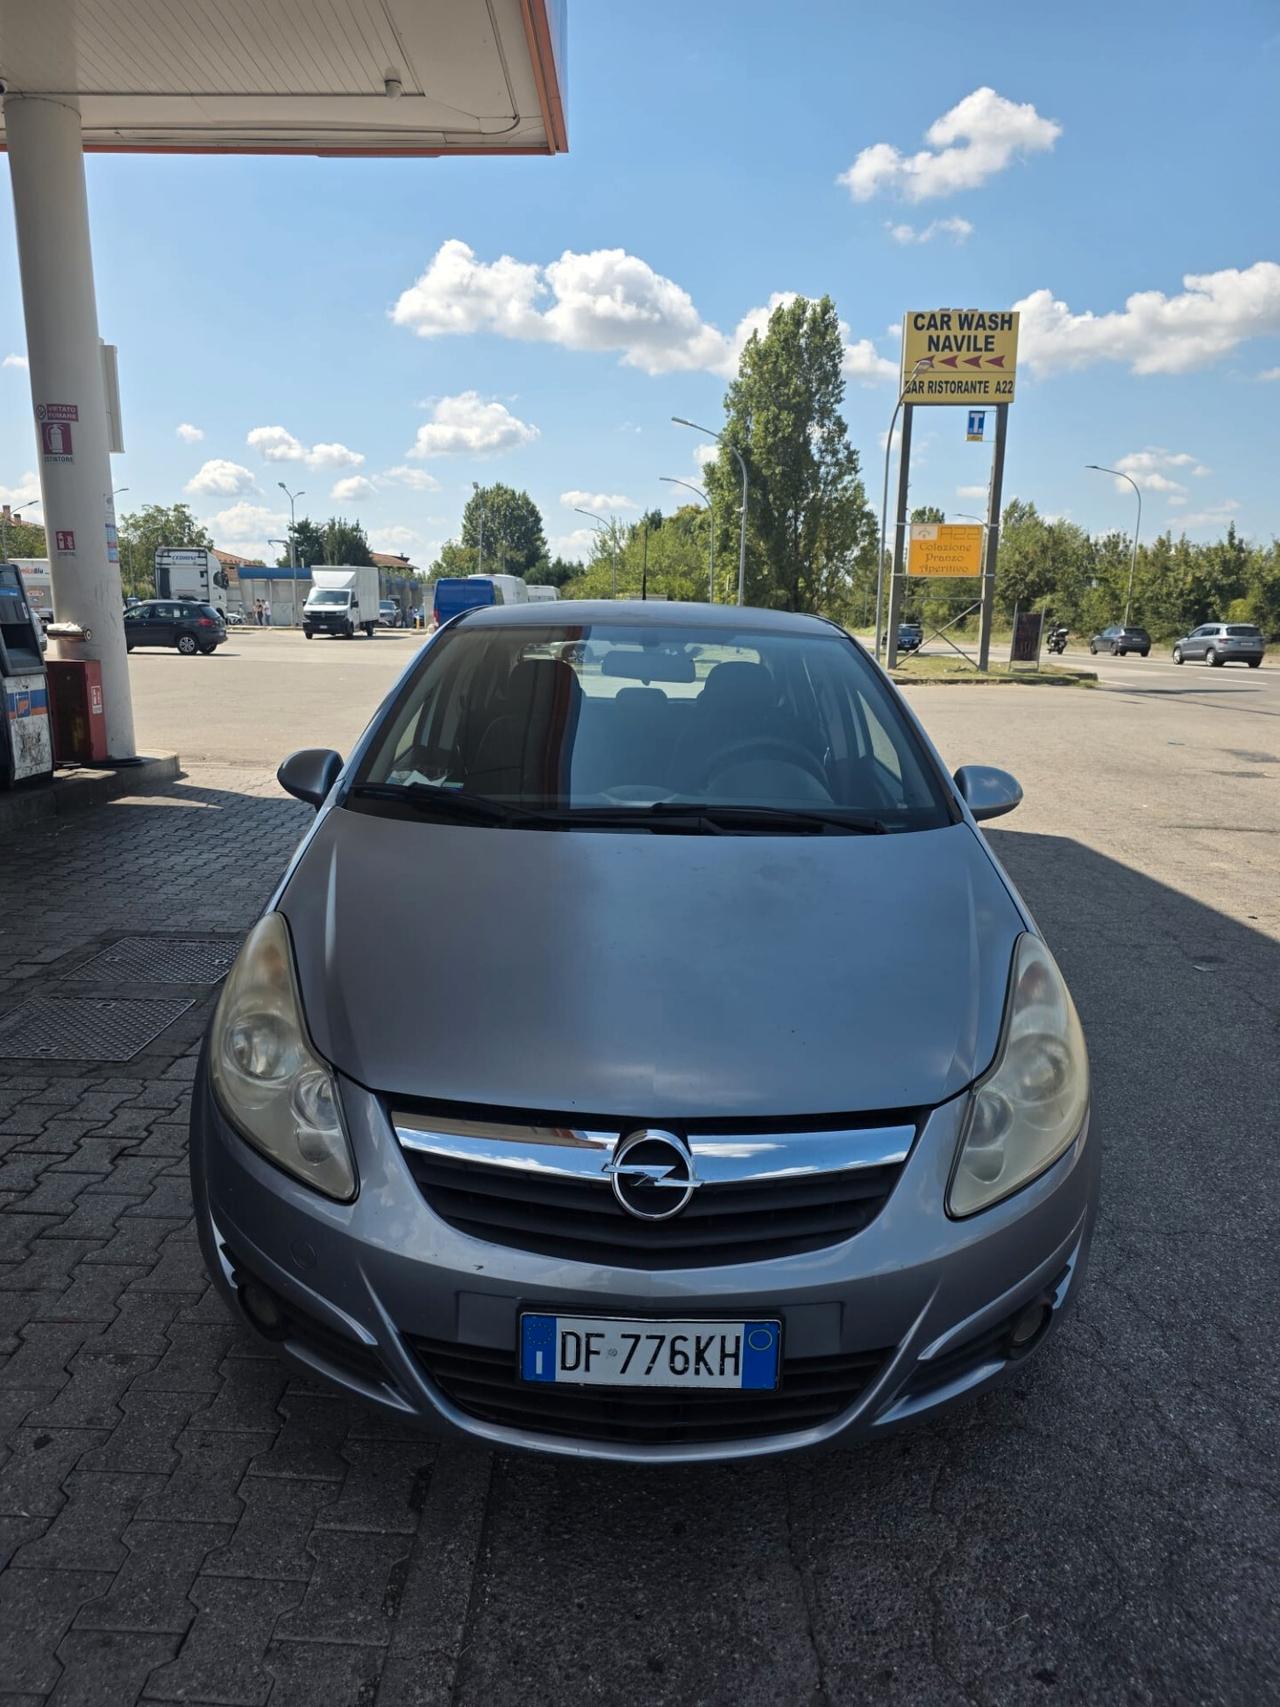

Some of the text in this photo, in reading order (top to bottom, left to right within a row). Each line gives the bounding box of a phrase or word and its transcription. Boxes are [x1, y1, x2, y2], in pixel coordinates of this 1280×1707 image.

[914, 313, 1013, 331] CAR WASH
[927, 335, 995, 352] NAVILE
[927, 380, 990, 394] RISTORANTE
[994, 380, 1014, 394] A22
[919, 542, 972, 552] Colazione
[926, 552, 965, 562] Pranzo
[919, 563, 969, 573] Aperitivo
[560, 1331, 741, 1376] DF 776KH
